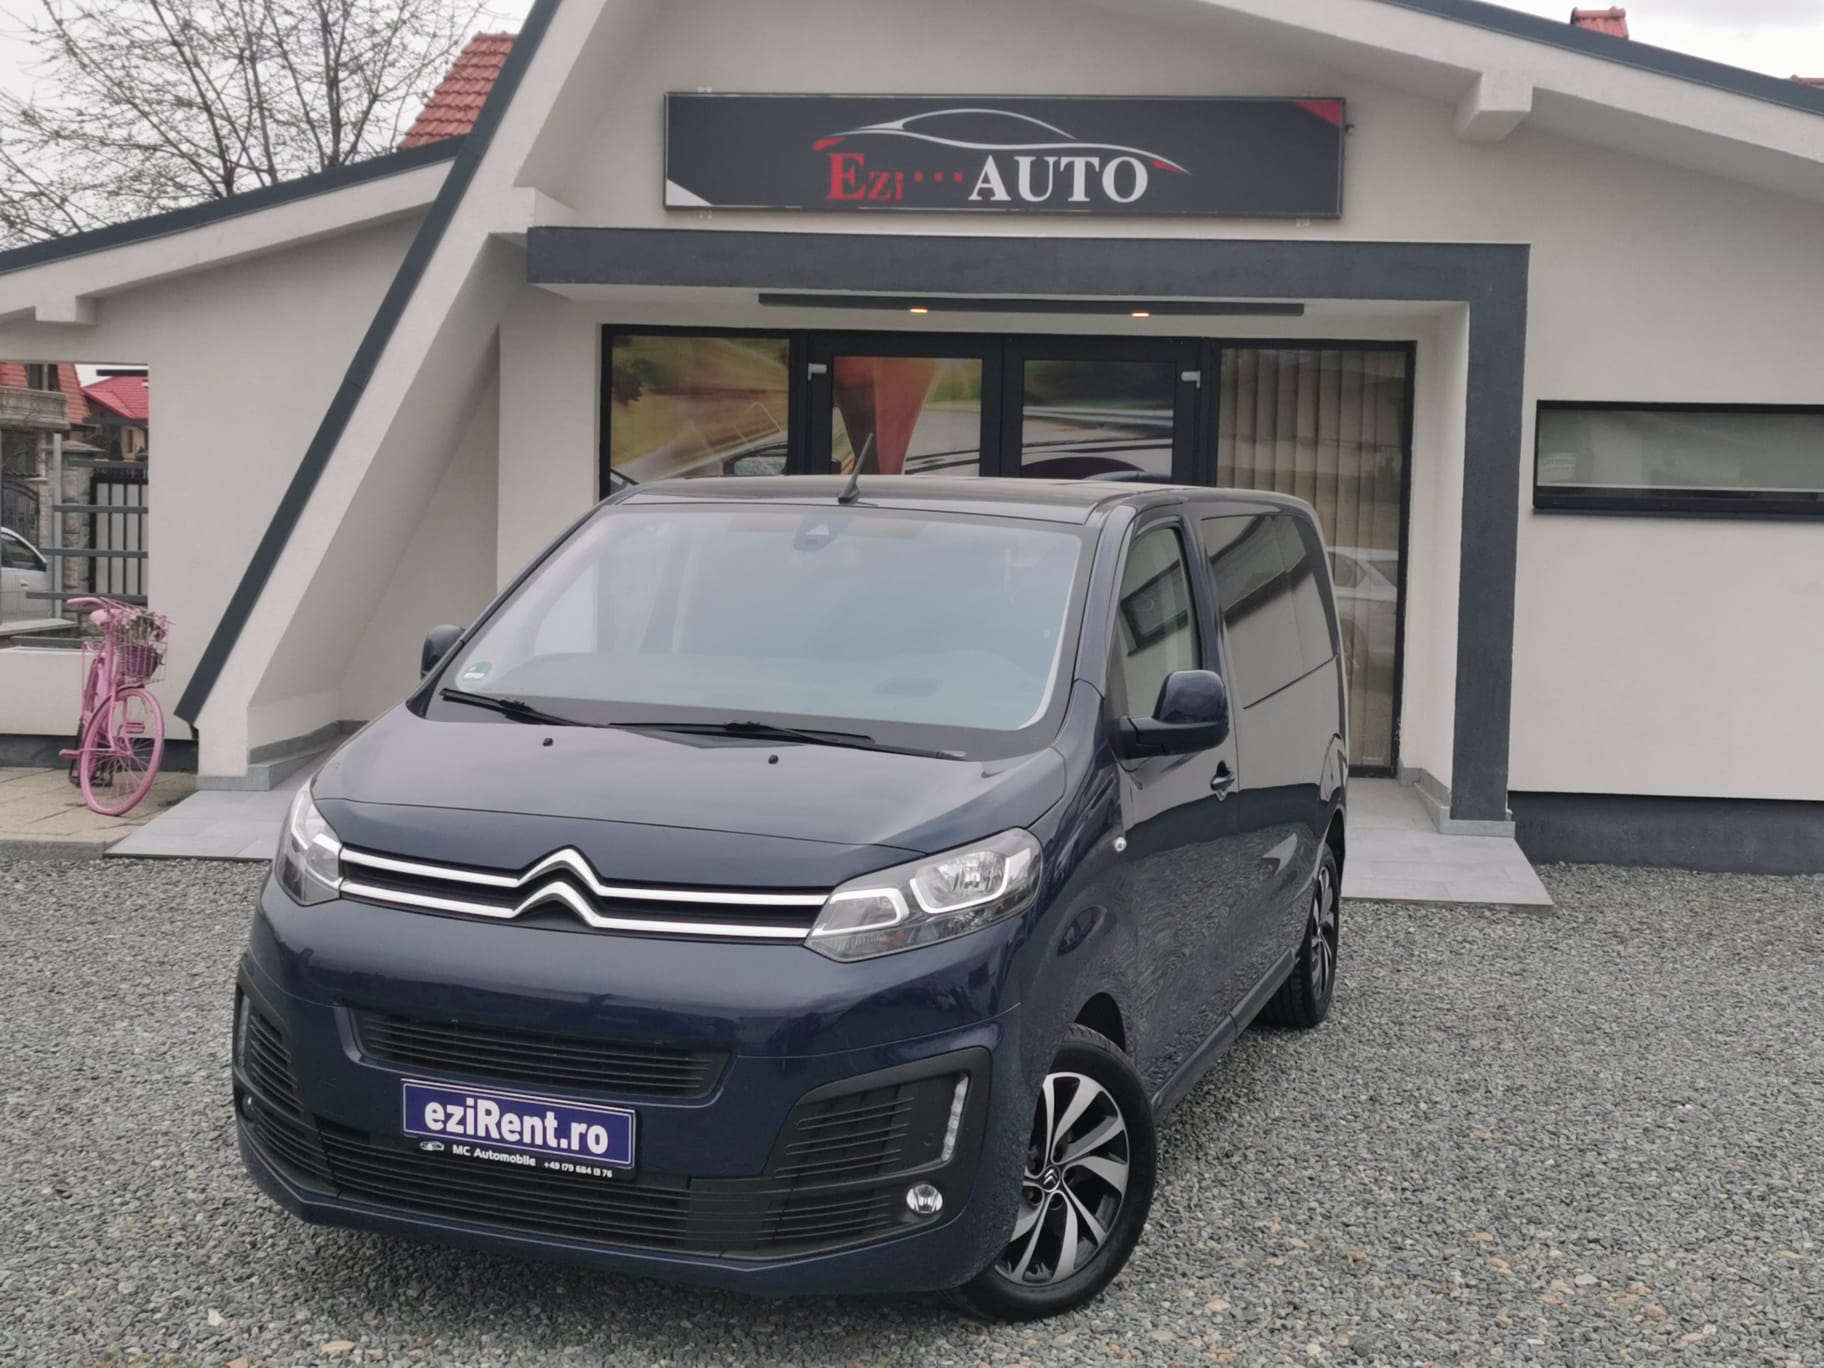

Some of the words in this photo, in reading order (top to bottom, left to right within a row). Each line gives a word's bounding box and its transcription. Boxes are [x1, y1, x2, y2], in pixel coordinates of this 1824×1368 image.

[968, 154, 1148, 203] AUTO
[424, 1097, 609, 1155] eziRent.ro
[452, 1144, 471, 1156] MC
[473, 1147, 536, 1167] Automobile
